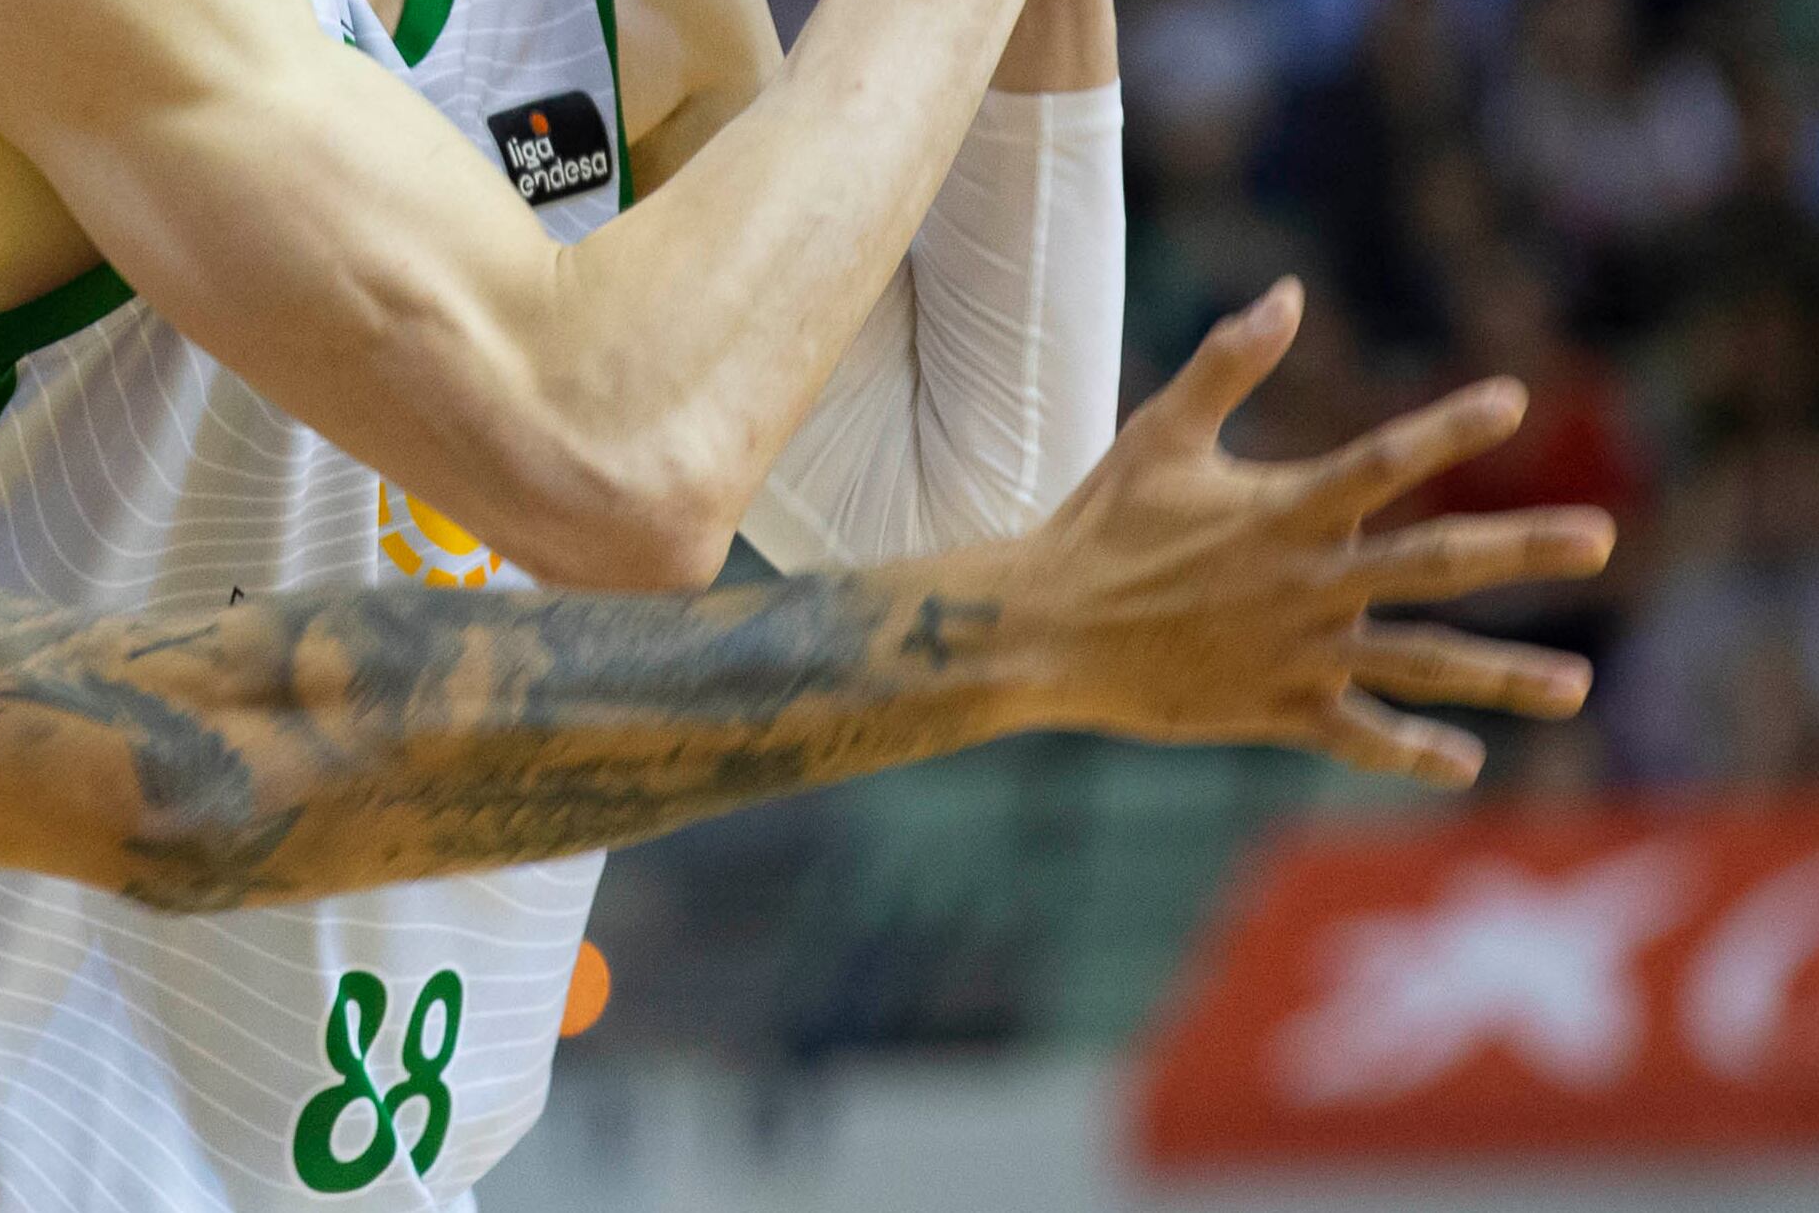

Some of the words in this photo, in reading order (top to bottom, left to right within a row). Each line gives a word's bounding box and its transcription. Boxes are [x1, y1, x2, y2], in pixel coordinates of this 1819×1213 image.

[506, 136, 555, 170] liga
[518, 149, 608, 197] endesa
[292, 968, 464, 1194] 88
